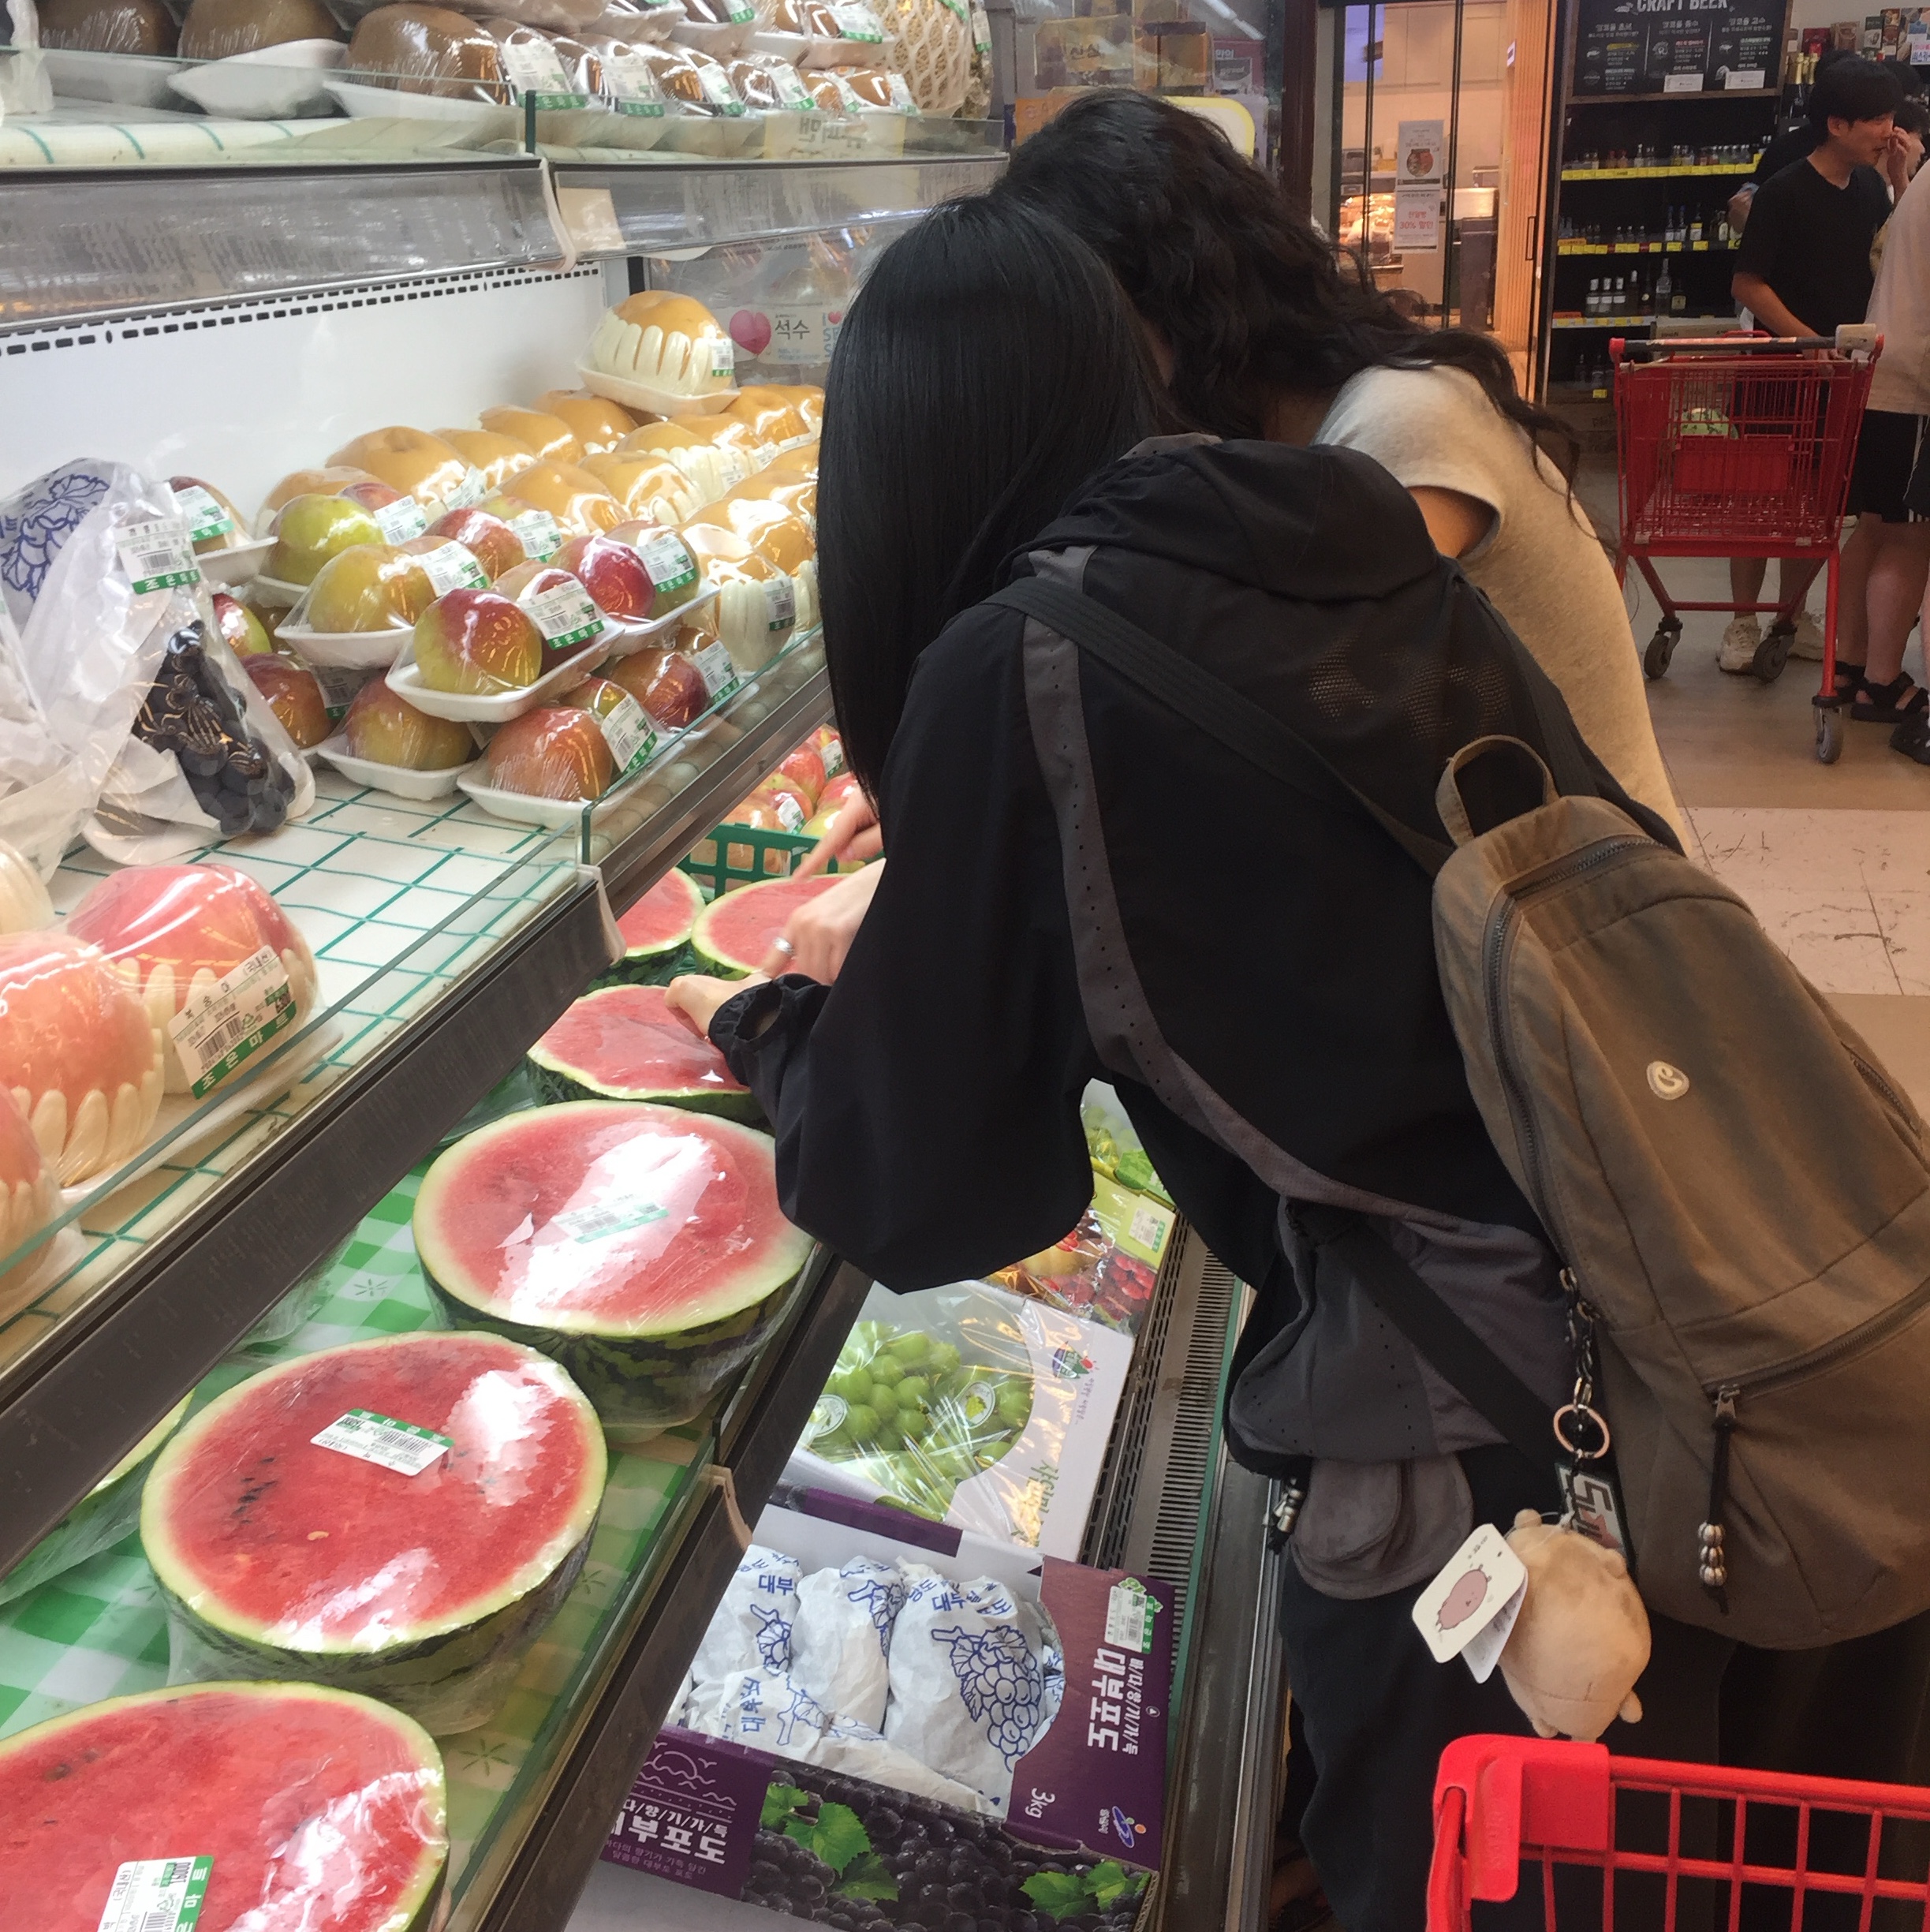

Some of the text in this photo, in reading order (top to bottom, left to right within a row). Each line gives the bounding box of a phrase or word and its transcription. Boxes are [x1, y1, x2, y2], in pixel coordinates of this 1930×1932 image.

[1637, 0, 1727, 12] CRAFT BEER
[775, 320, 810, 339] 석수
[202, 1015, 289, 1091] 조은마트
[1088, 1647, 1126, 1751] 대부포도
[1025, 1788, 1056, 1819] 3kg
[610, 1811, 726, 1865] 부포도
[113, 1869, 132, 1901] (국내산)
